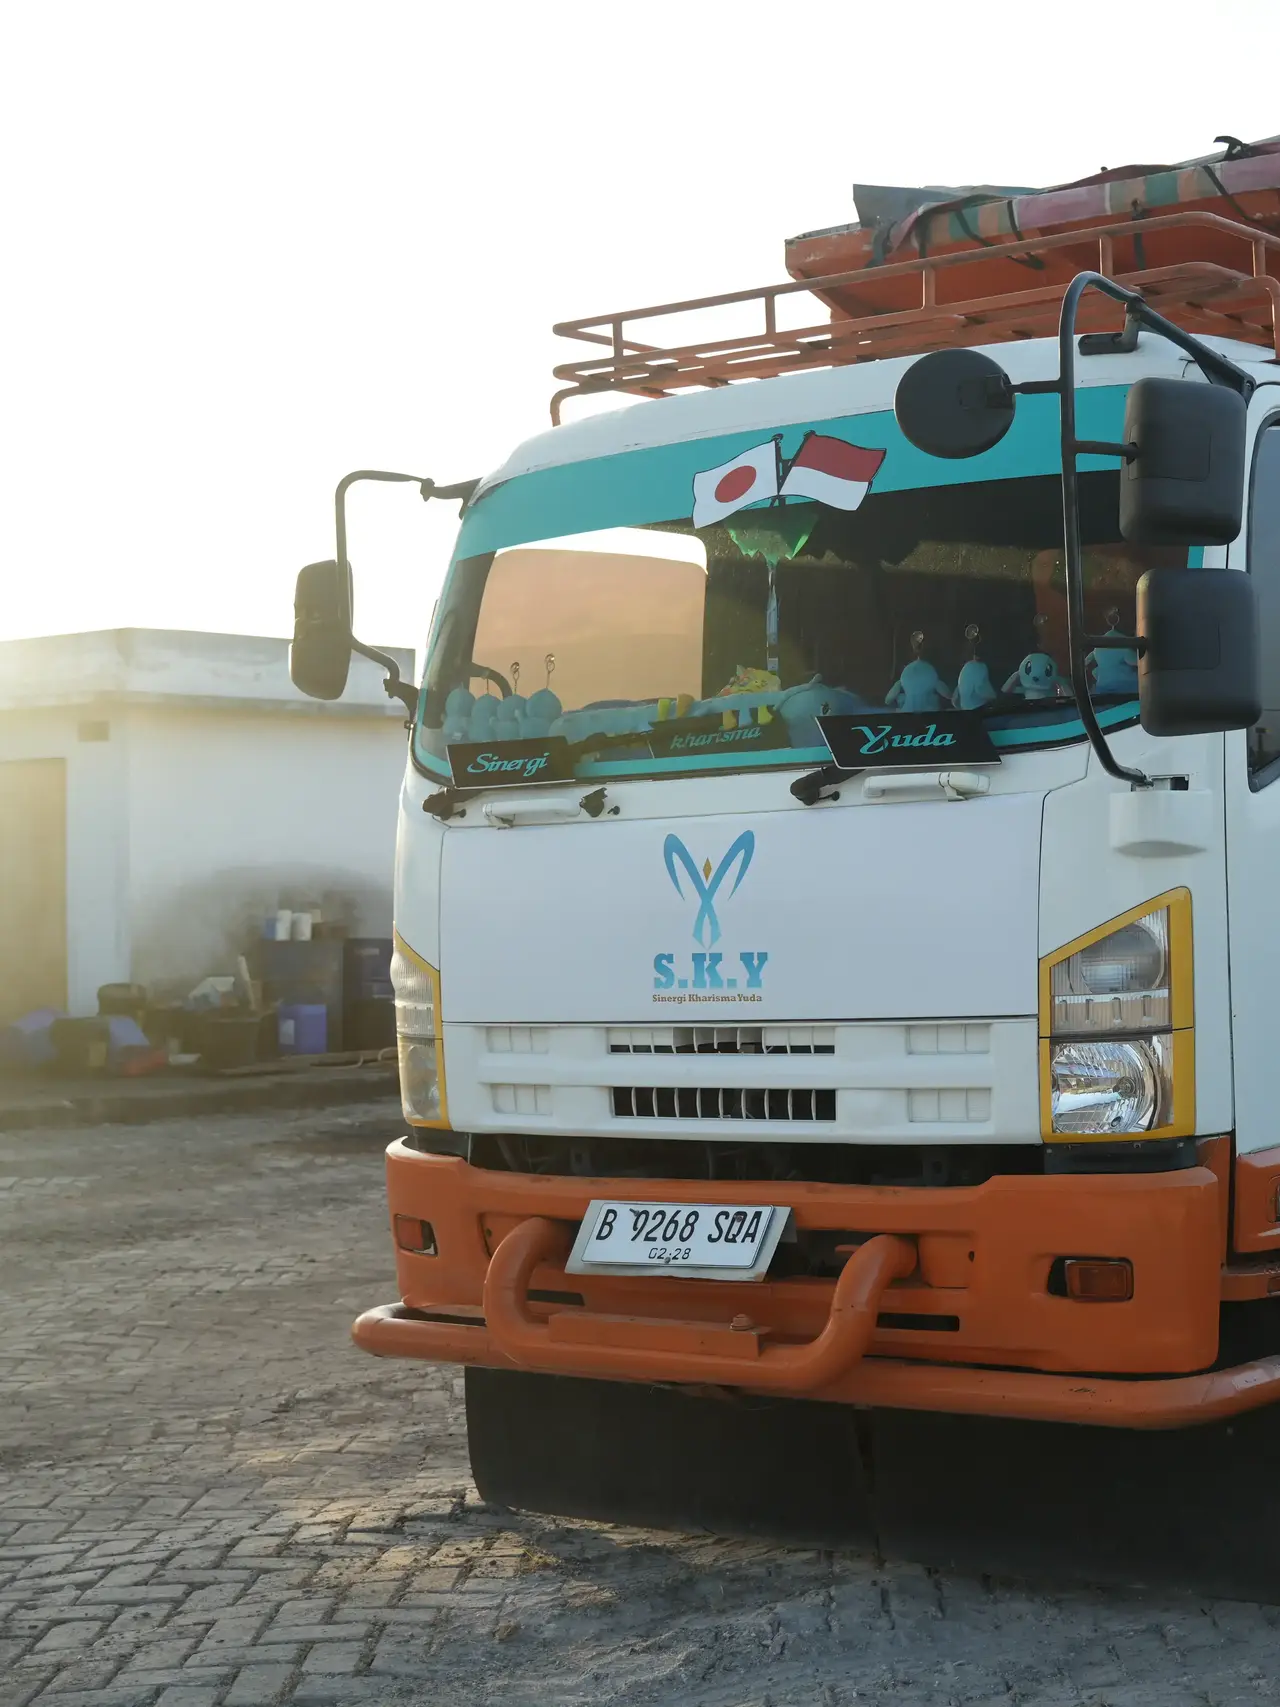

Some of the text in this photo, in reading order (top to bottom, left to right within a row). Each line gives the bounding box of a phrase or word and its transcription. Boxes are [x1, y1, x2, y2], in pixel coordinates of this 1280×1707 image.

[851, 723, 957, 755] Yuda
[466, 752, 551, 777] Sinergi
[653, 951, 769, 990] S.K.Y
[652, 993, 763, 1005] Sinergi Kharisma Yuda
[595, 1208, 763, 1244] B 9268 SQA
